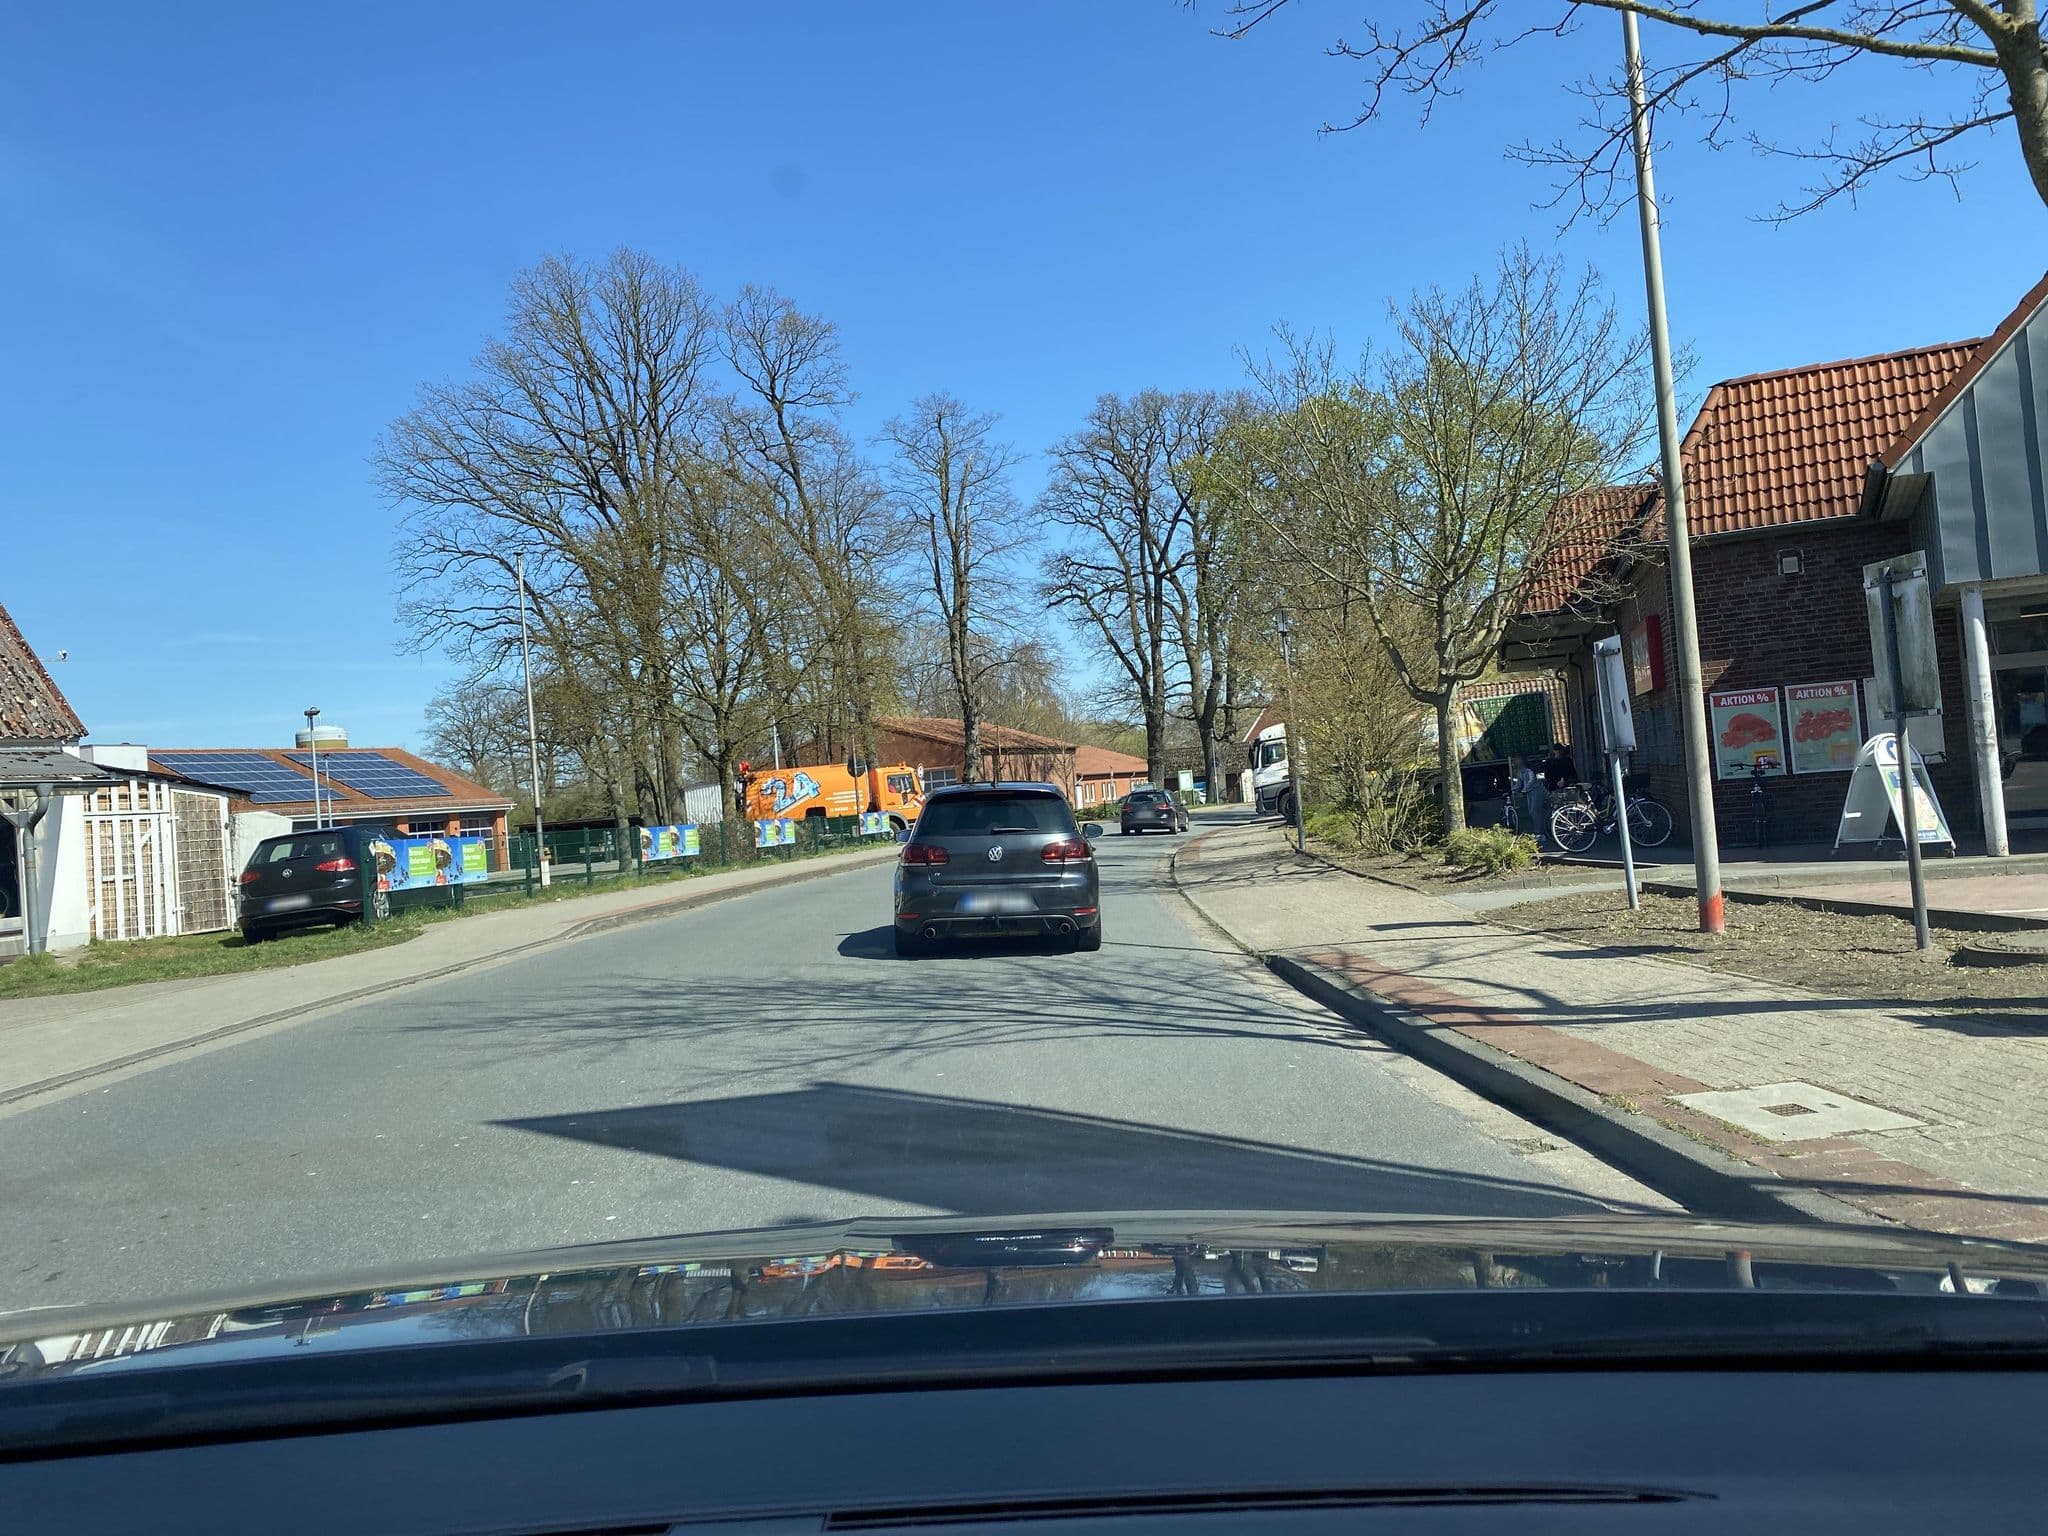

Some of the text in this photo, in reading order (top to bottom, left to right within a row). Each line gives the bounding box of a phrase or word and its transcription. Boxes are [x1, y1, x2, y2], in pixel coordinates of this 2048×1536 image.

[1796, 686, 1847, 699] AKTION %
[1720, 693, 1769, 706] AKTION %
